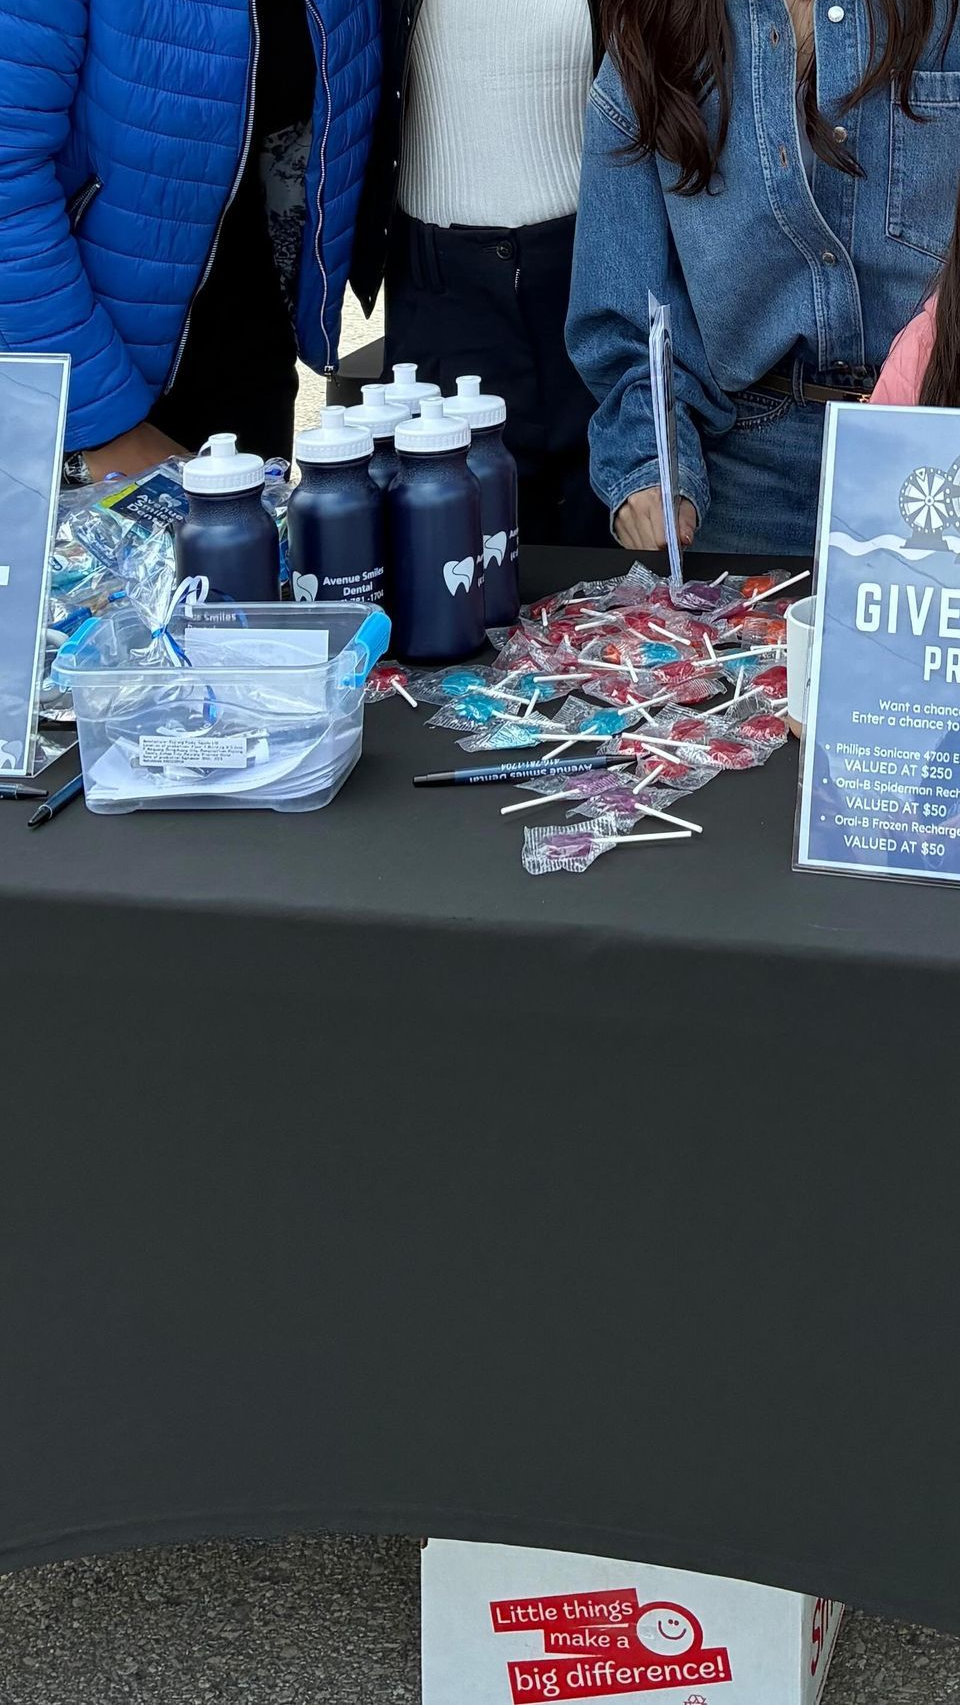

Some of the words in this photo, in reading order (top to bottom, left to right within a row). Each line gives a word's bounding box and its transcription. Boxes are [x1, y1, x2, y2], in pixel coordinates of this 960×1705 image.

[136, 494, 184, 522] Avenue
[323, 575, 361, 585] Avenue
[343, 582, 373, 596] Dental
[879, 699, 910, 713] Want
[913, 704, 920, 713] a
[852, 711, 884, 724] Enter
[888, 716, 896, 726] a
[899, 716, 943, 731] chance
[947, 720, 960, 732] to
[836, 743, 870, 757] Philips
[873, 746, 921, 761] Sonicare
[923, 750, 950, 763] 4700
[509, 768, 547, 779] Smiles
[549, 763, 593, 776] Avenue
[844, 758, 897, 775] VALUED
[901, 763, 917, 776] AT
[921, 766, 953, 781] $250
[836, 778, 871, 791] Oral-B
[873, 781, 933, 797] Spiderman
[845, 796, 899, 813] VALUED
[902, 801, 919, 815] AT
[923, 804, 947, 818] $50
[835, 815, 869, 828] Oral-B
[872, 818, 908, 832] Frozen
[844, 835, 897, 852] VALUED
[900, 840, 917, 854] AT
[921, 843, 945, 857] $50
[495, 1603, 558, 1625] Little
[563, 1599, 634, 1622] things
[550, 1628, 611, 1648] make
[616, 1635, 630, 1649] a
[514, 1667, 560, 1696] big
[566, 1656, 726, 1688] difference!
